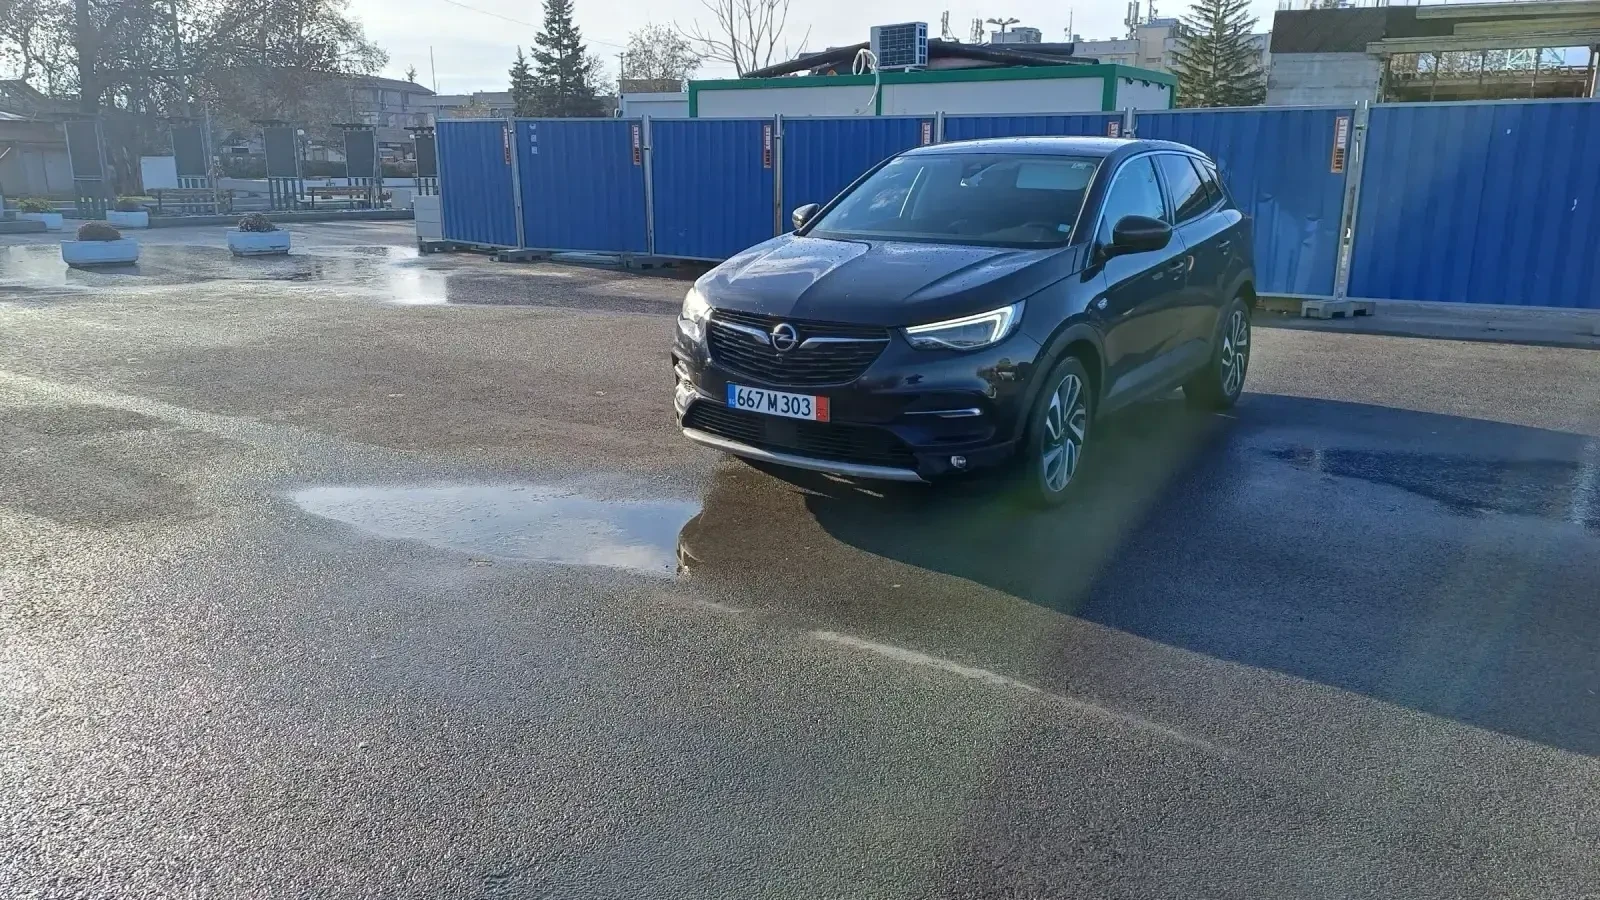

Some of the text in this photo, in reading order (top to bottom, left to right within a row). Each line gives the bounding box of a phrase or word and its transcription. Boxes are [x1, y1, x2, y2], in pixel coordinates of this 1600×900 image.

[737, 388, 764, 409] 667
[767, 393, 778, 412] M
[780, 395, 811, 416] 303
